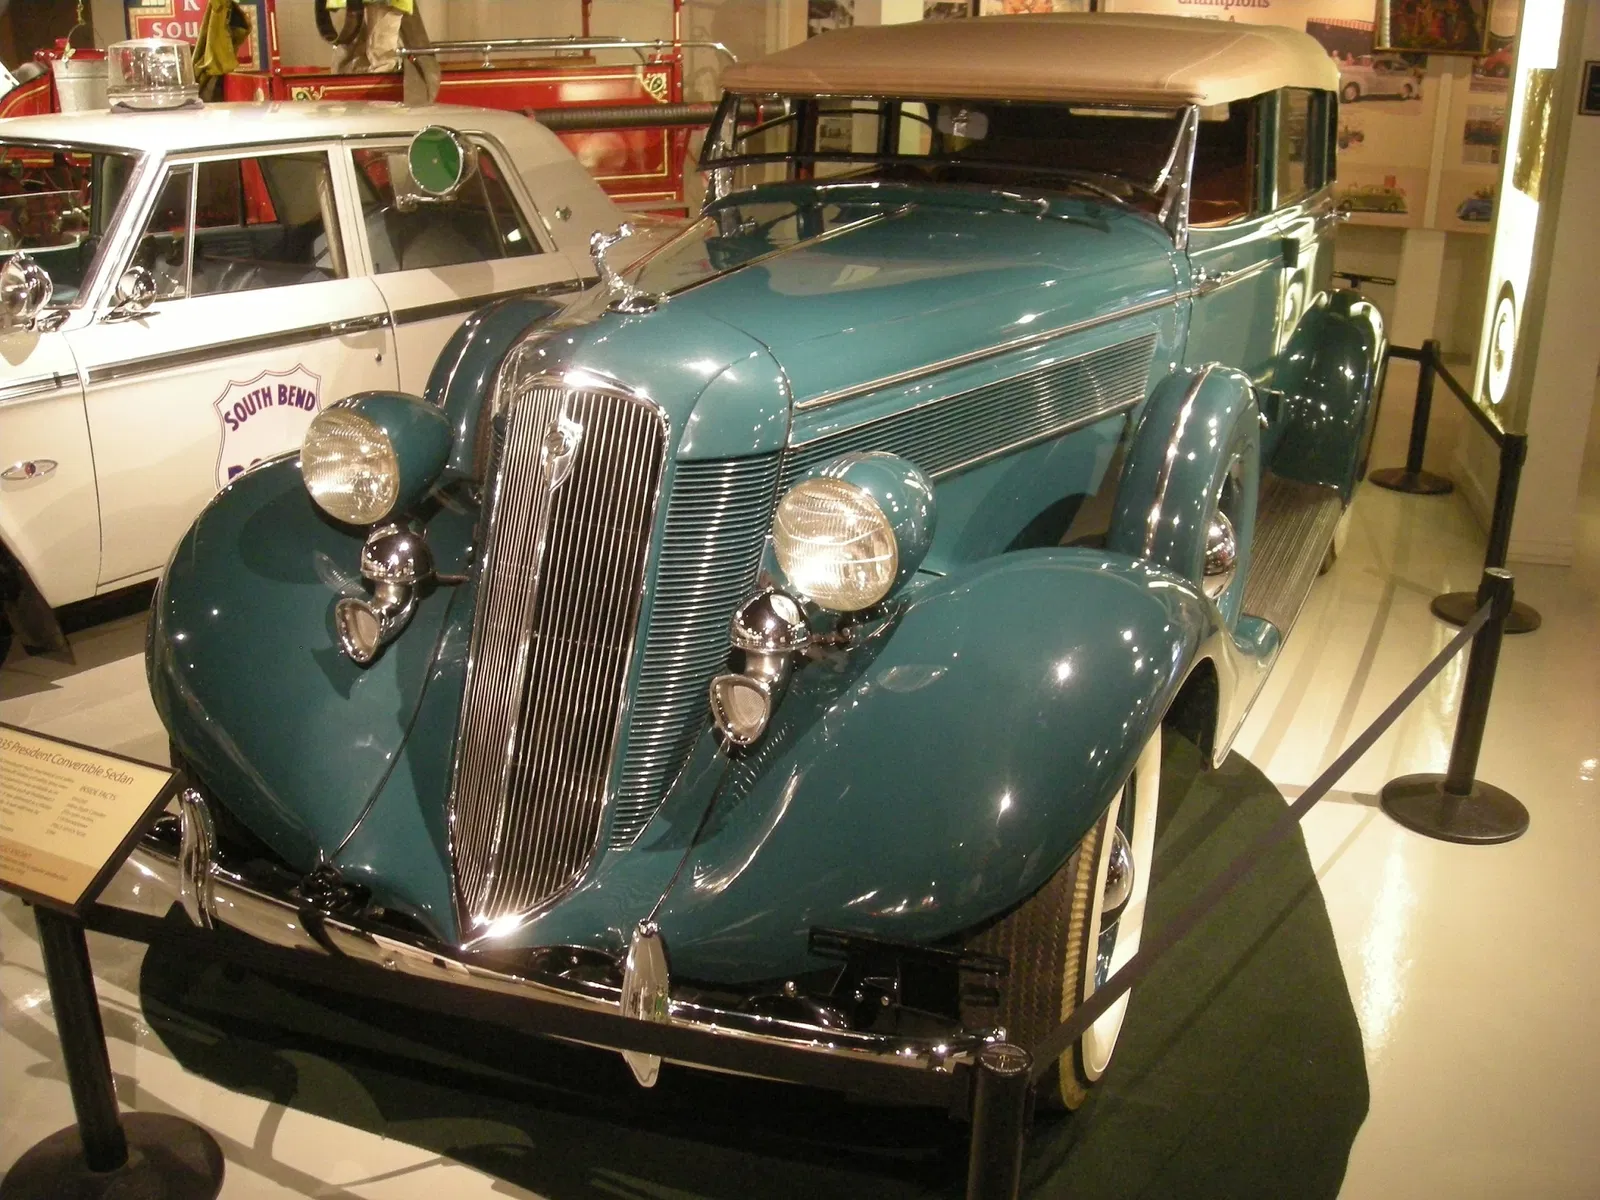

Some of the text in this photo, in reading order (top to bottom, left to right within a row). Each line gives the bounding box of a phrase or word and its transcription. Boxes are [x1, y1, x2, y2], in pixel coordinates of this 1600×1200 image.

[152, 21, 199, 38] SOU
[224, 384, 316, 431] SOUTH BEND
[11, 741, 52, 762] President
[51, 753, 104, 776] Convertible
[103, 767, 134, 785] Sedan
